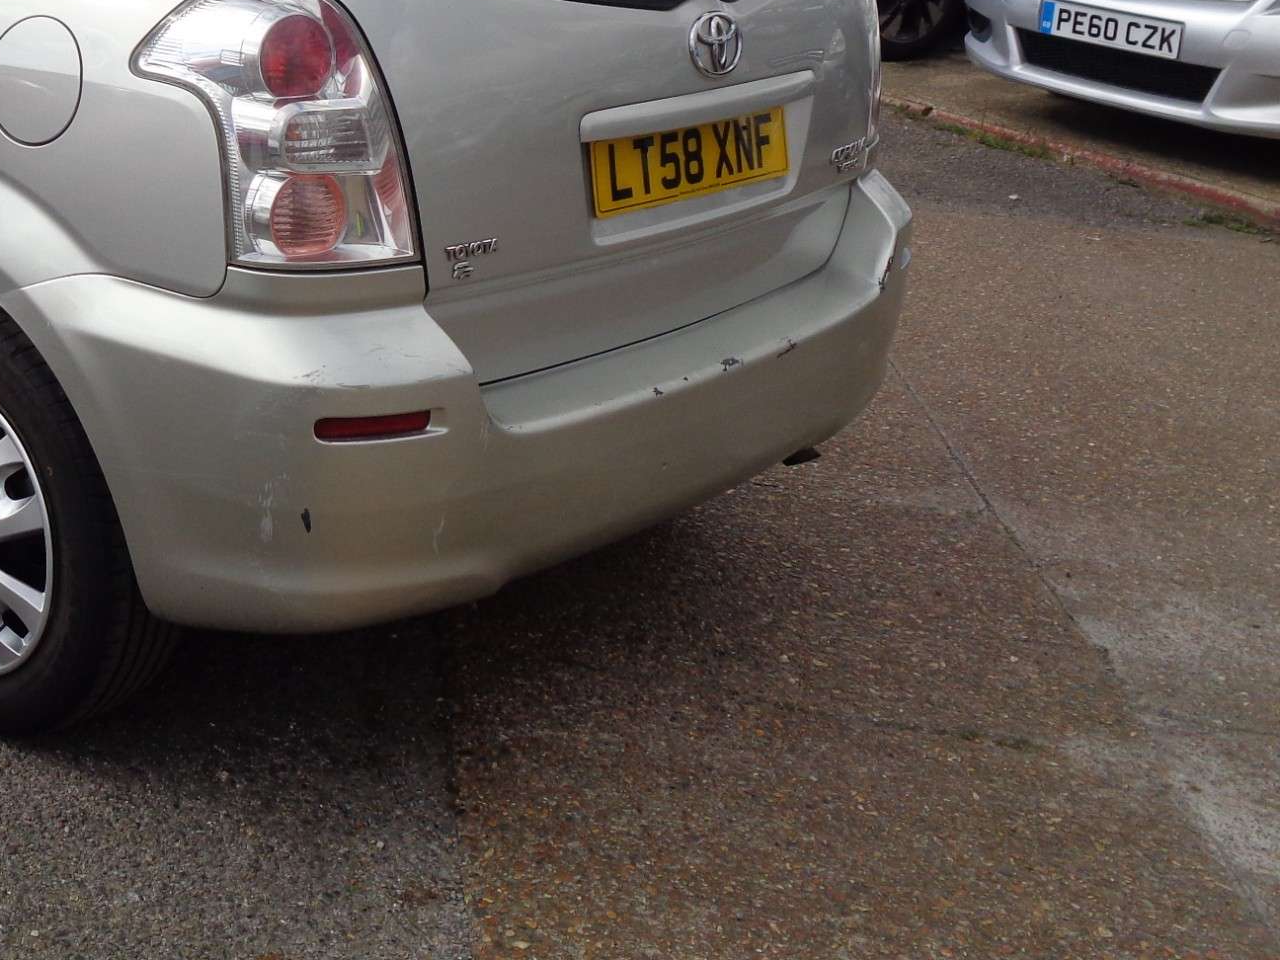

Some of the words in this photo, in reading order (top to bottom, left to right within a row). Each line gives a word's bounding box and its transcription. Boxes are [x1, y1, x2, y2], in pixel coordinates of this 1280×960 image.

[1056, 8, 1119, 41] PE60
[1125, 21, 1176, 53] CZK
[608, 128, 705, 202] LT58
[712, 113, 773, 179] XNF
